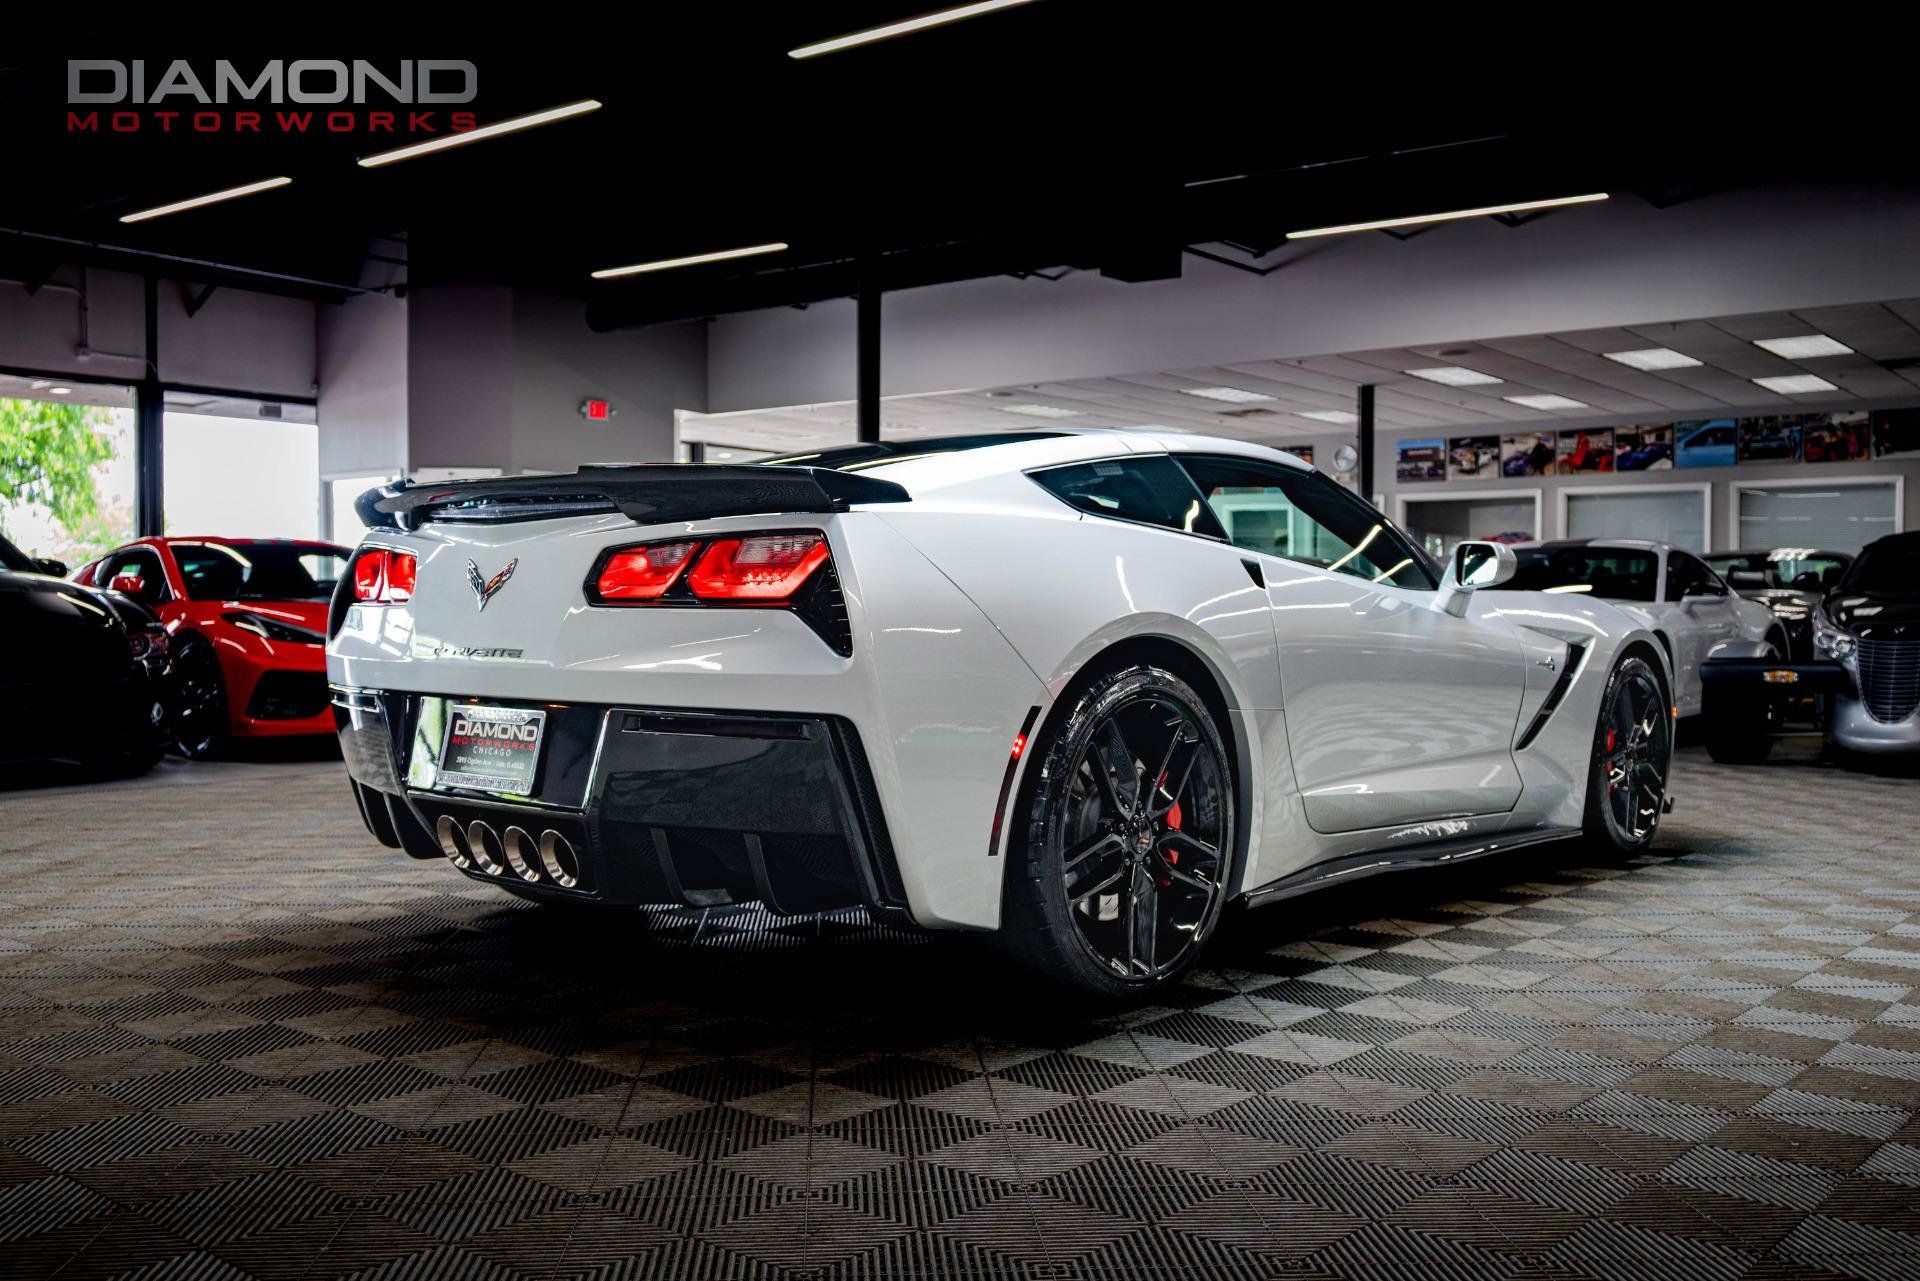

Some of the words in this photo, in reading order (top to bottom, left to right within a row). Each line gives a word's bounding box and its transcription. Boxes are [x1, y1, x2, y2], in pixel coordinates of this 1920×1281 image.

[454, 719, 538, 742] DIAMOND
[452, 736, 536, 753] MOTORWORKS
[472, 746, 512, 757] CHICAGO
